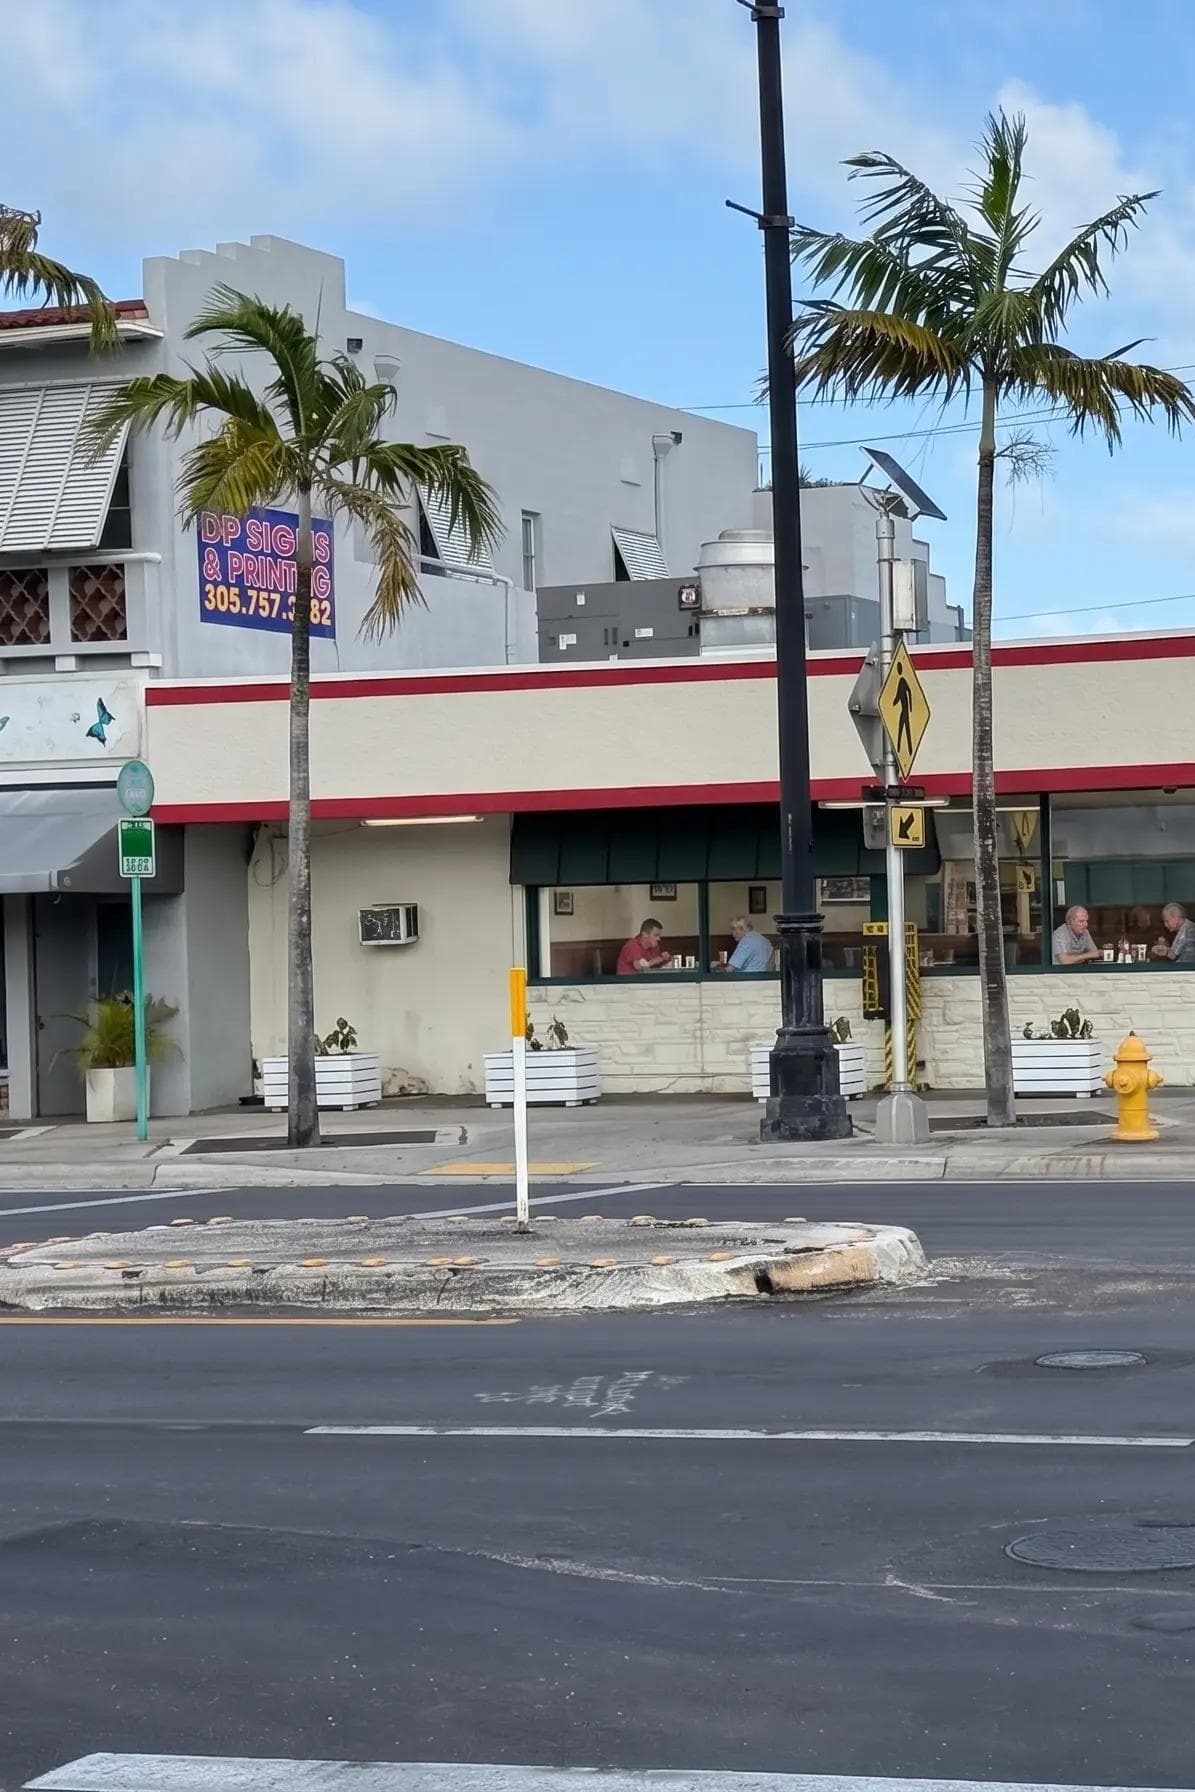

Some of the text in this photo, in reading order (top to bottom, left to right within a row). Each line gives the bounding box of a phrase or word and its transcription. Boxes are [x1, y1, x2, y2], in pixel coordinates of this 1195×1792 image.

[201, 511, 330, 563] DP SIGS
[203, 547, 331, 599] & PRINTG
[204, 583, 332, 626] 305.757.382
